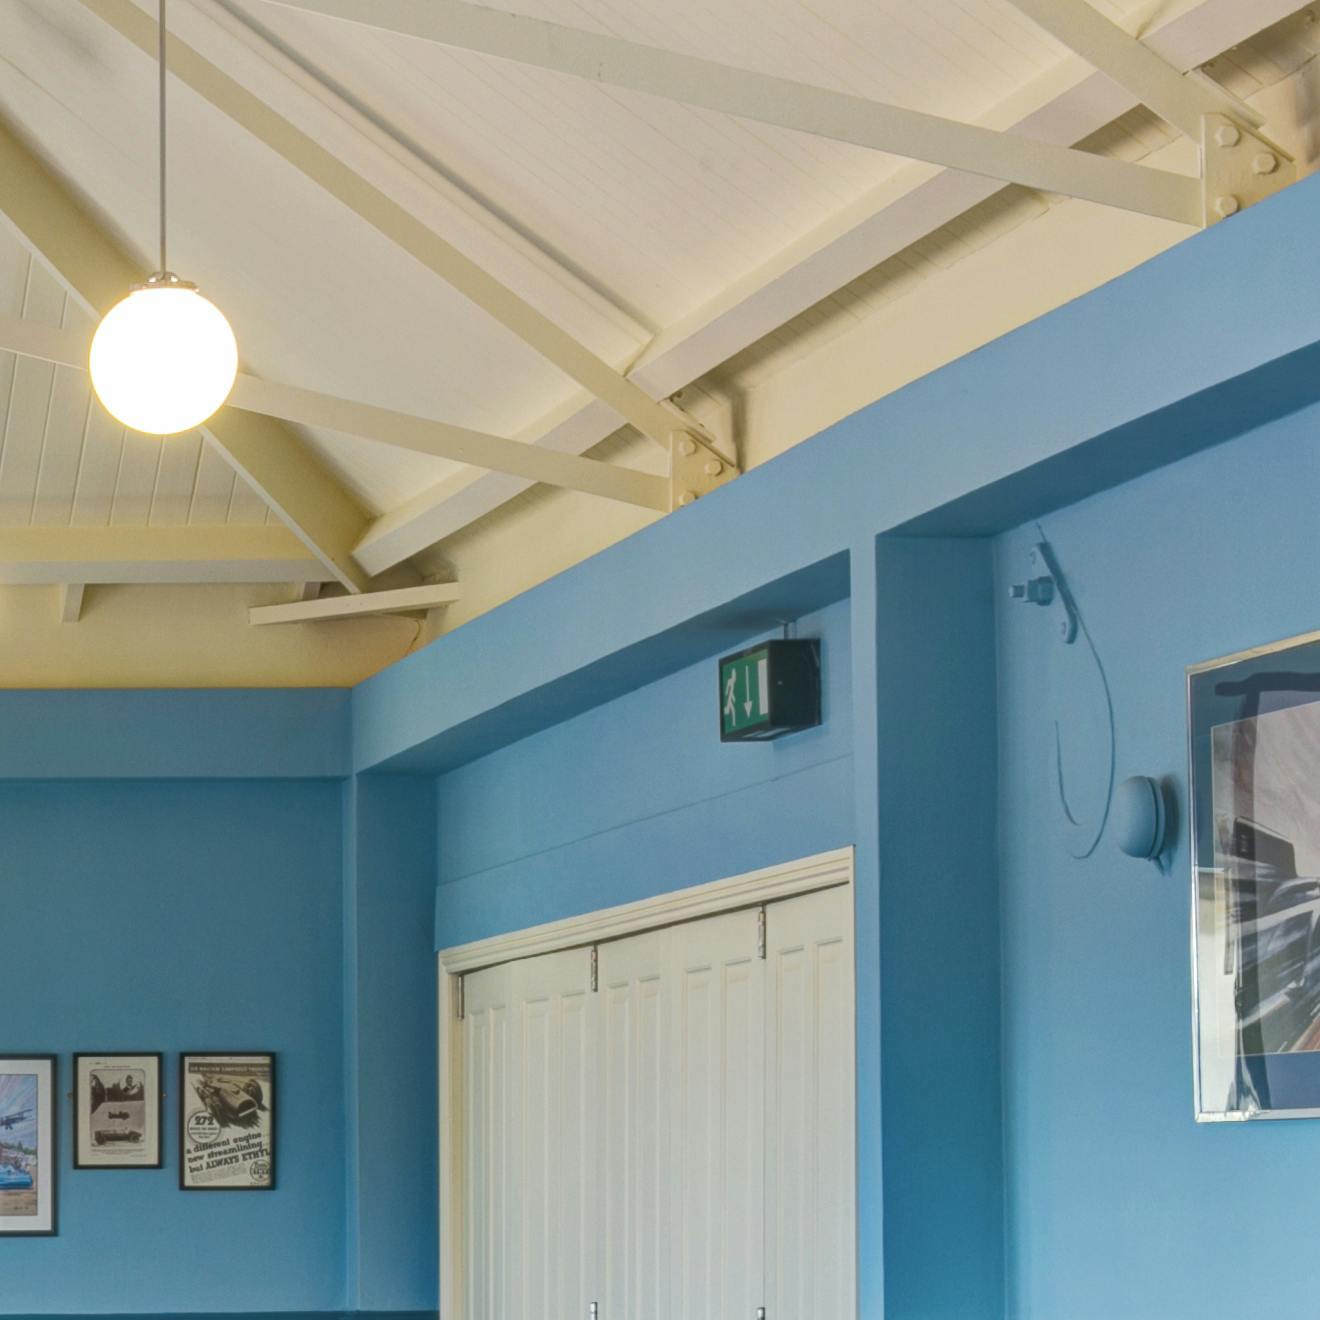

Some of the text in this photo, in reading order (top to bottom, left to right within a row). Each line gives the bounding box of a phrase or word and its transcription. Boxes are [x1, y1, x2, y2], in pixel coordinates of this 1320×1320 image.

[195, 1116, 214, 1125] 272
[193, 1137, 230, 1153] different
[233, 1133, 262, 1143] engine
[187, 1154, 205, 1163] new
[205, 1155, 239, 1170] ALWAYS
